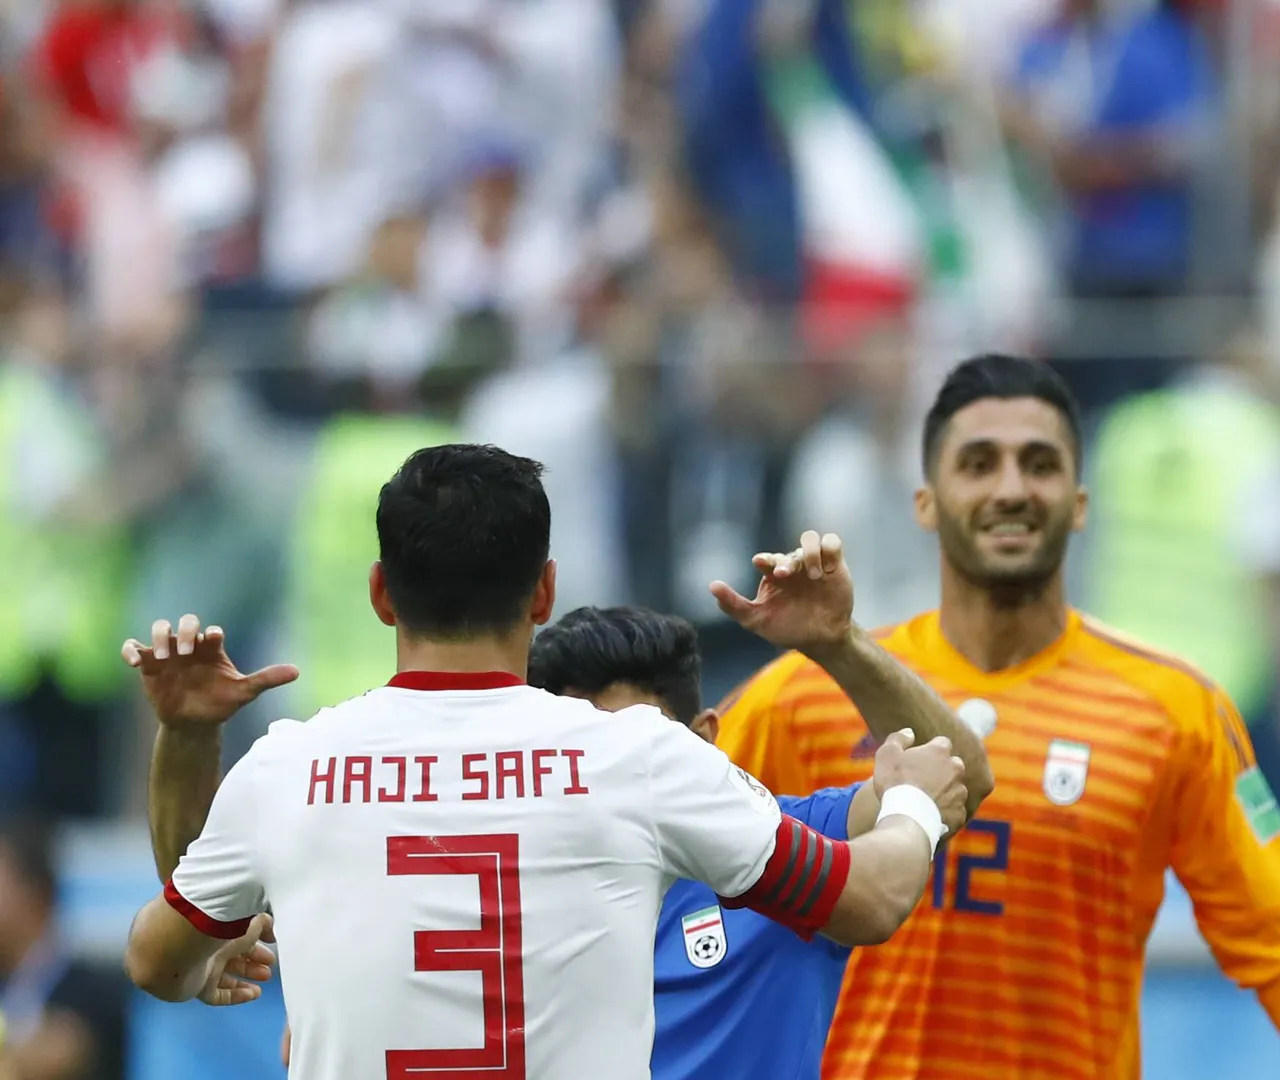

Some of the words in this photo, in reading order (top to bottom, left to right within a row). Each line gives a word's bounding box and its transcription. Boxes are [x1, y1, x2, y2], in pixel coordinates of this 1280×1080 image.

[306, 755, 438, 805] HAJI
[461, 748, 589, 801] SAFI
[932, 819, 1010, 914] 12
